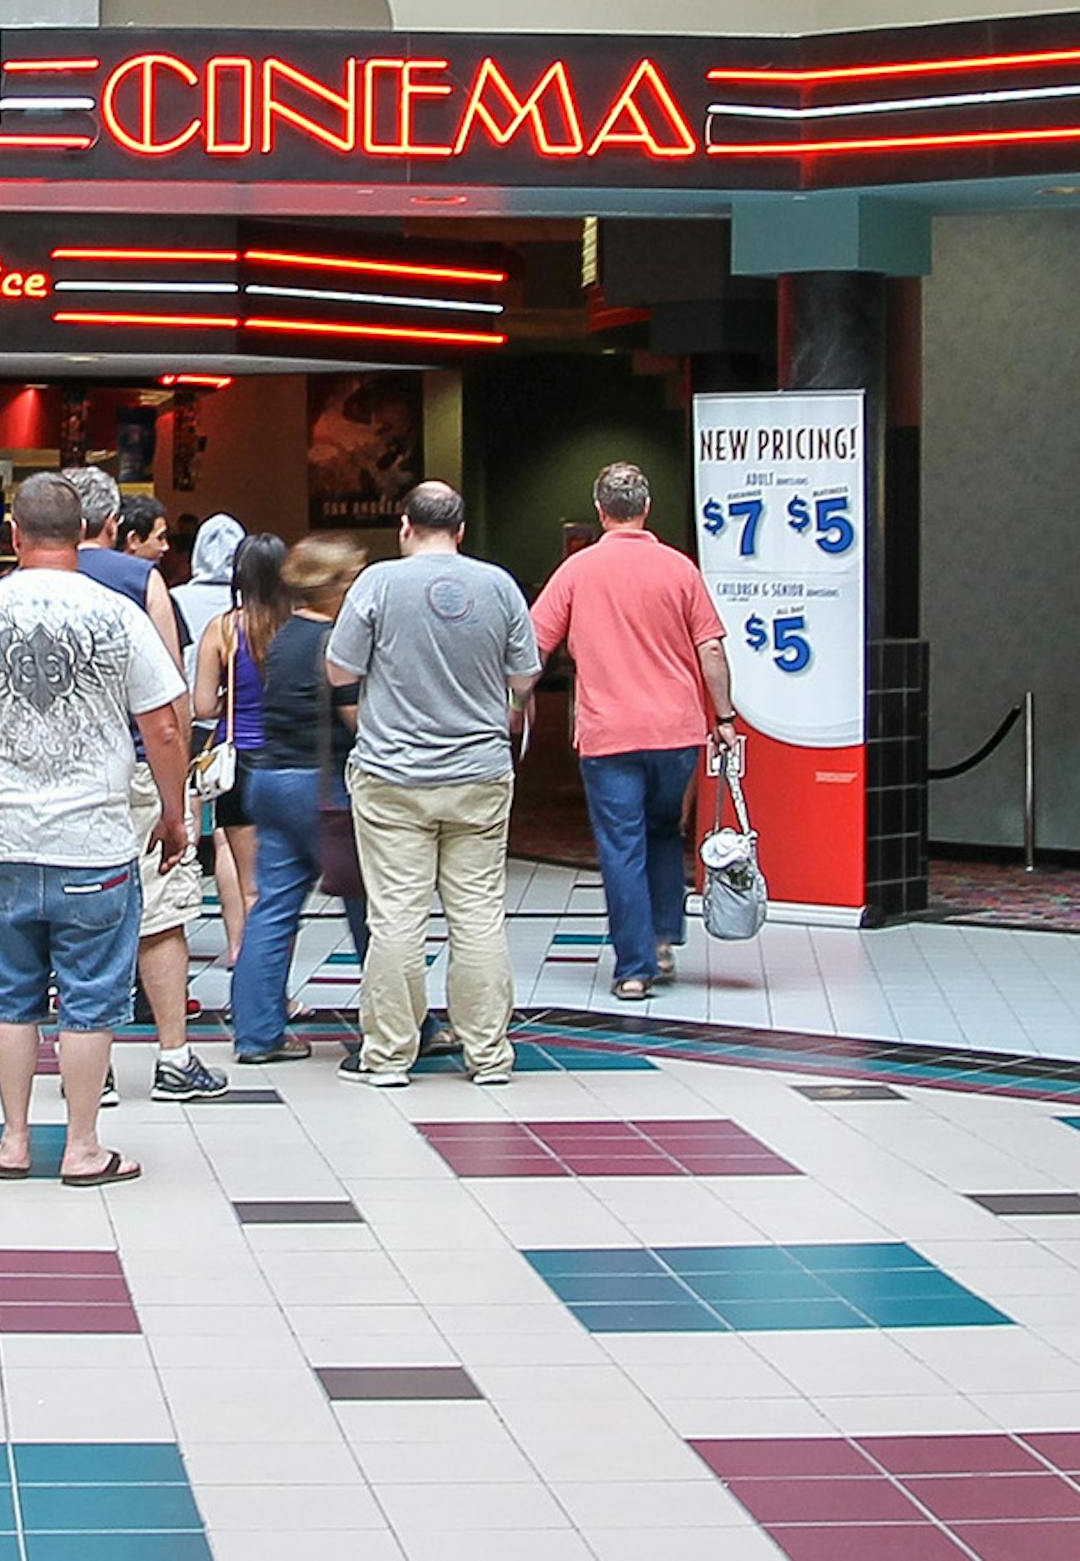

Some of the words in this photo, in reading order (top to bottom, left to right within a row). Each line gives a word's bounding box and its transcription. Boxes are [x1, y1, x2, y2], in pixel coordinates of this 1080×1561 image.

[102, 52, 697, 156] CINEMA
[700, 428, 748, 461] NEW
[757, 426, 857, 460] PRICING!
[745, 472, 774, 486] ADULT
[703, 497, 763, 556] $7
[787, 494, 854, 554] $5
[717, 582, 759, 597] CHILDREN
[771, 583, 803, 597] SENIOR
[745, 612, 811, 673] $5
